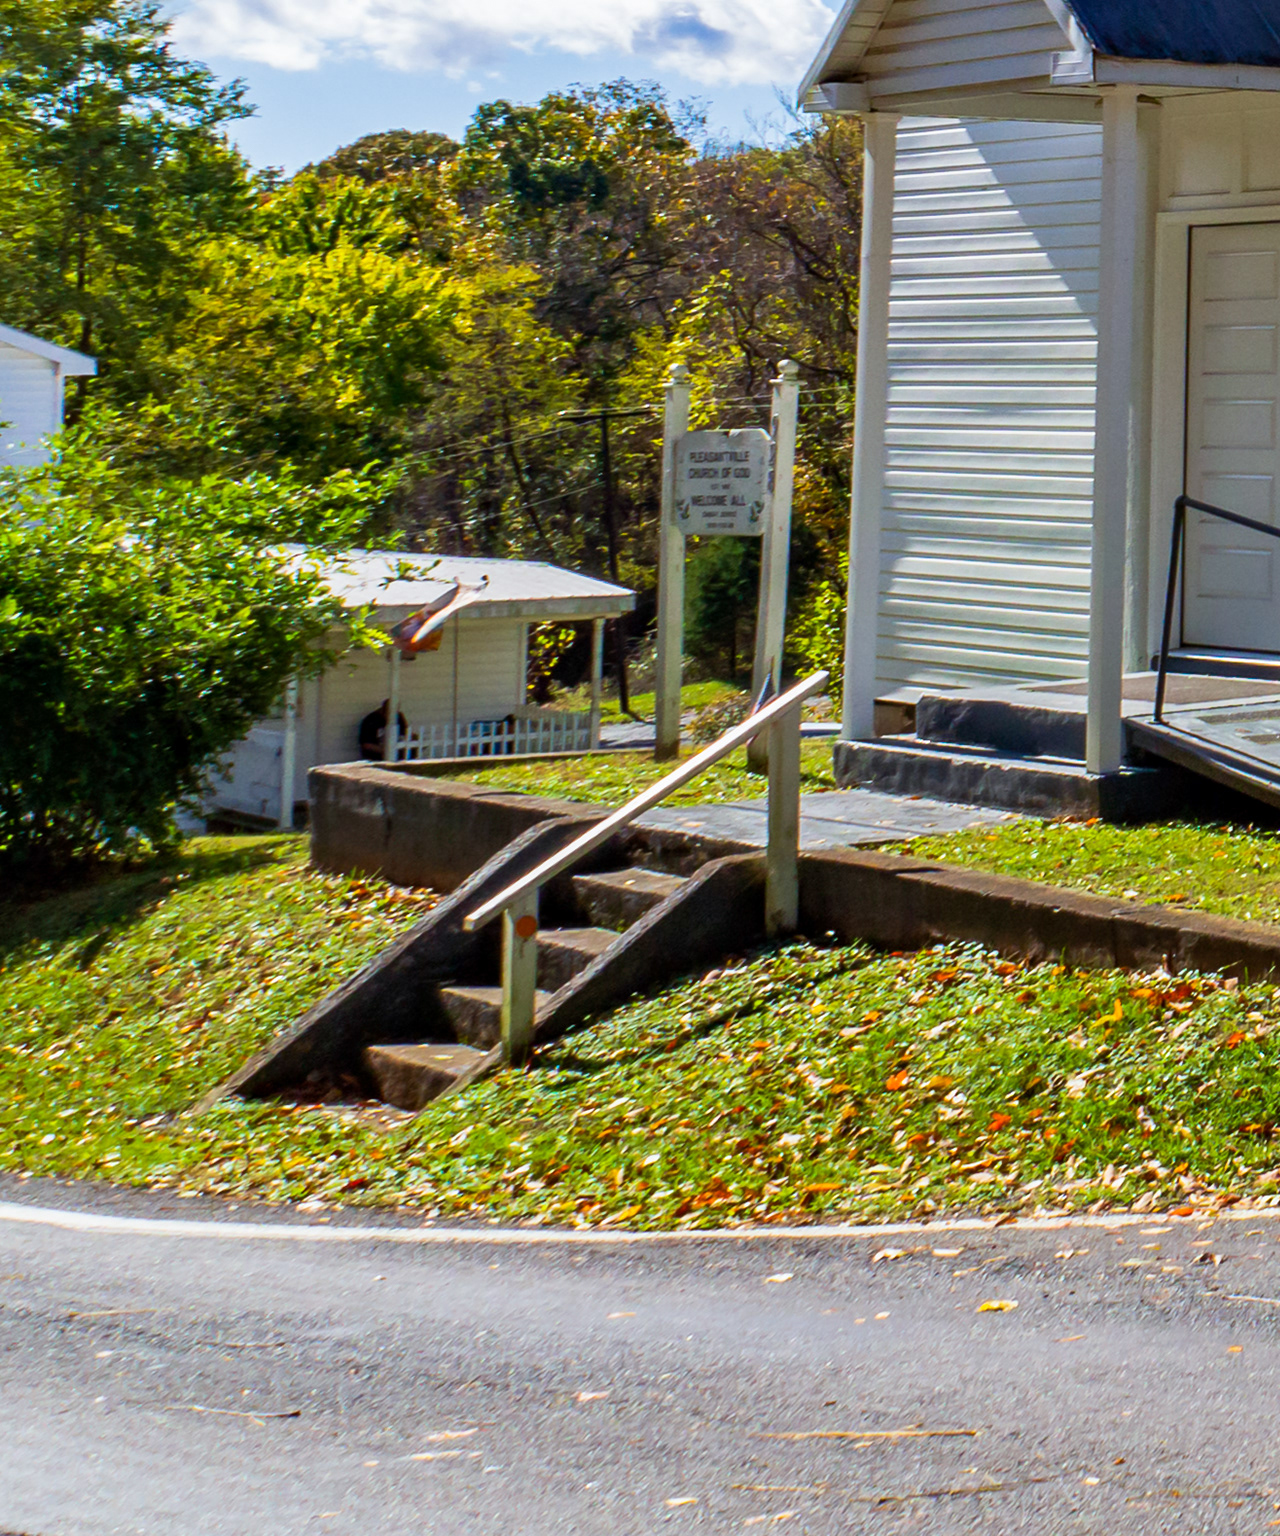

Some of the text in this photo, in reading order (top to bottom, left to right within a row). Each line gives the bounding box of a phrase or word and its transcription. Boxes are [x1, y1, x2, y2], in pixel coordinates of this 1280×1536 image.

[690, 451, 750, 462] PLEASANTVILLE
[689, 467, 750, 479] CHURCH OF GOD
[691, 495, 747, 506] WELCOME ALL
